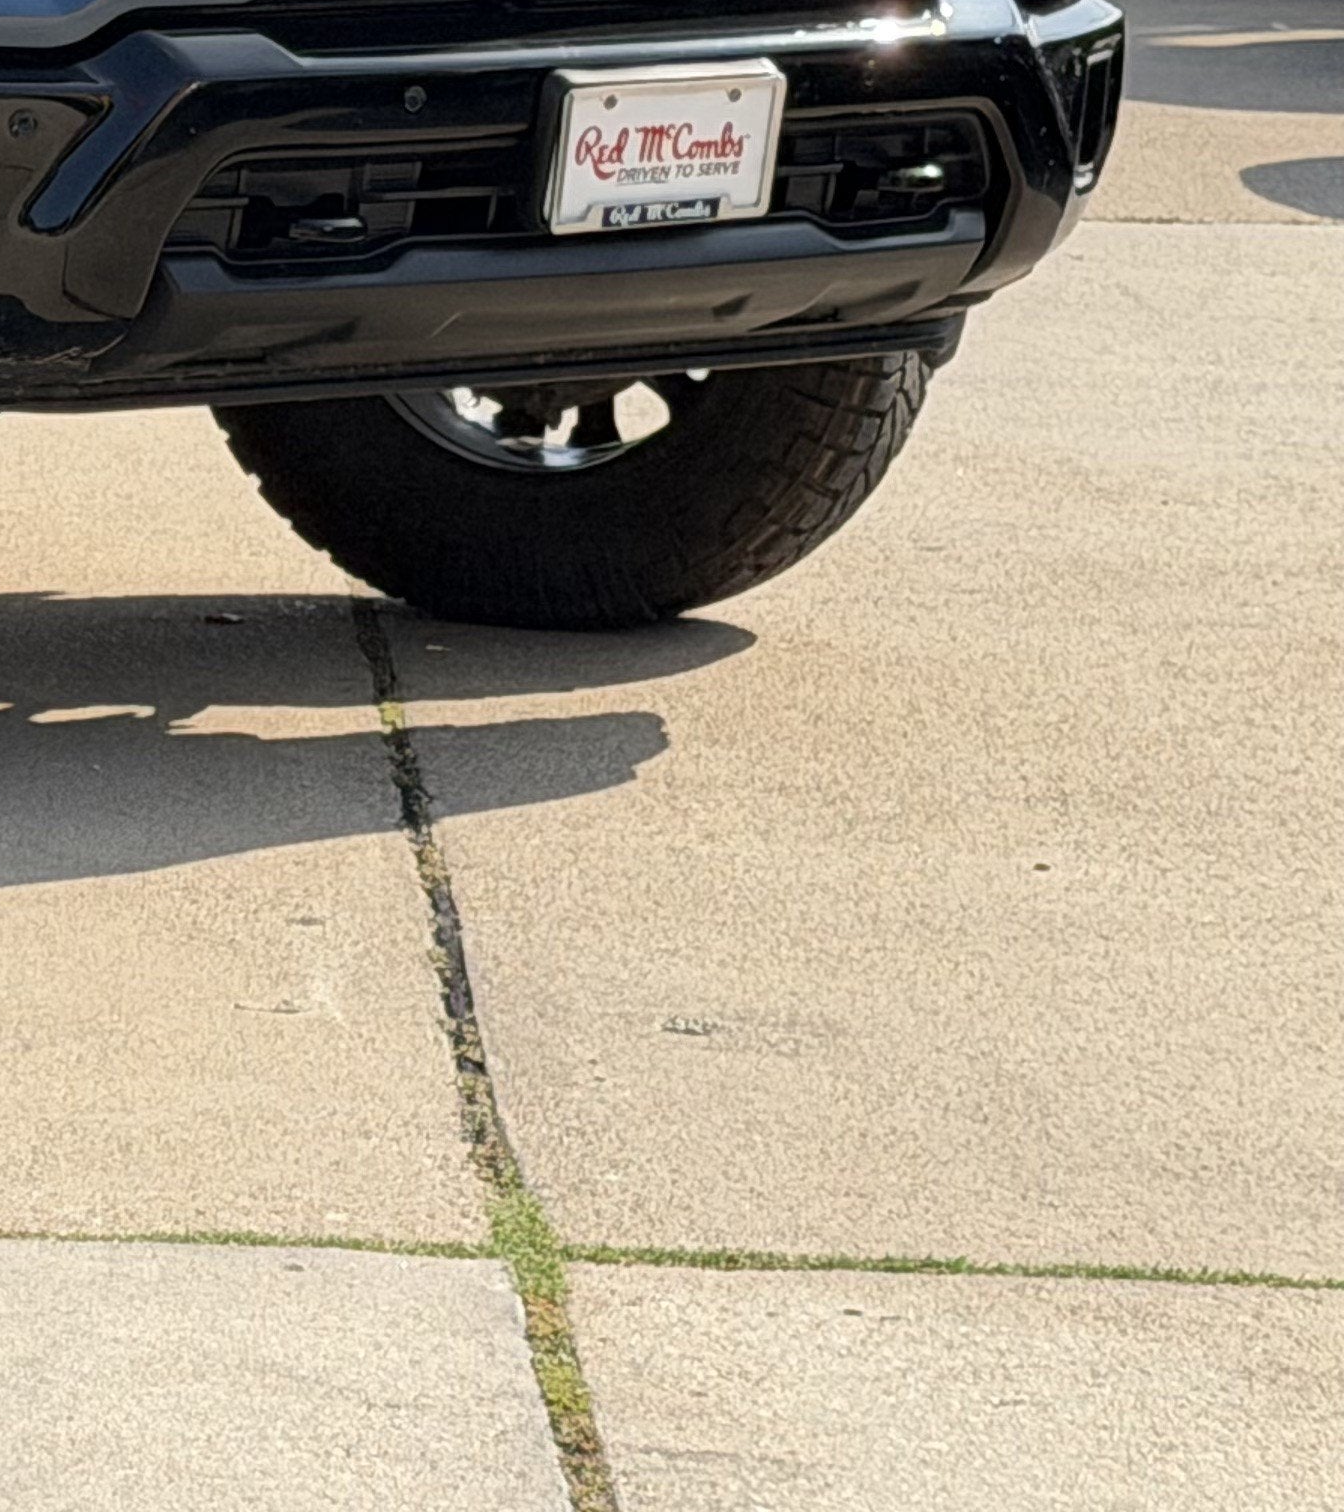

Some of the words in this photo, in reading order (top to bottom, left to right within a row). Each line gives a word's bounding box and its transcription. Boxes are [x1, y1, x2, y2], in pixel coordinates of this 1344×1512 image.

[574, 125, 630, 180] Red
[635, 121, 745, 163] McCombs
[616, 165, 672, 183] DRIVEN
[674, 164, 695, 179] TO
[696, 160, 741, 177] SERVE
